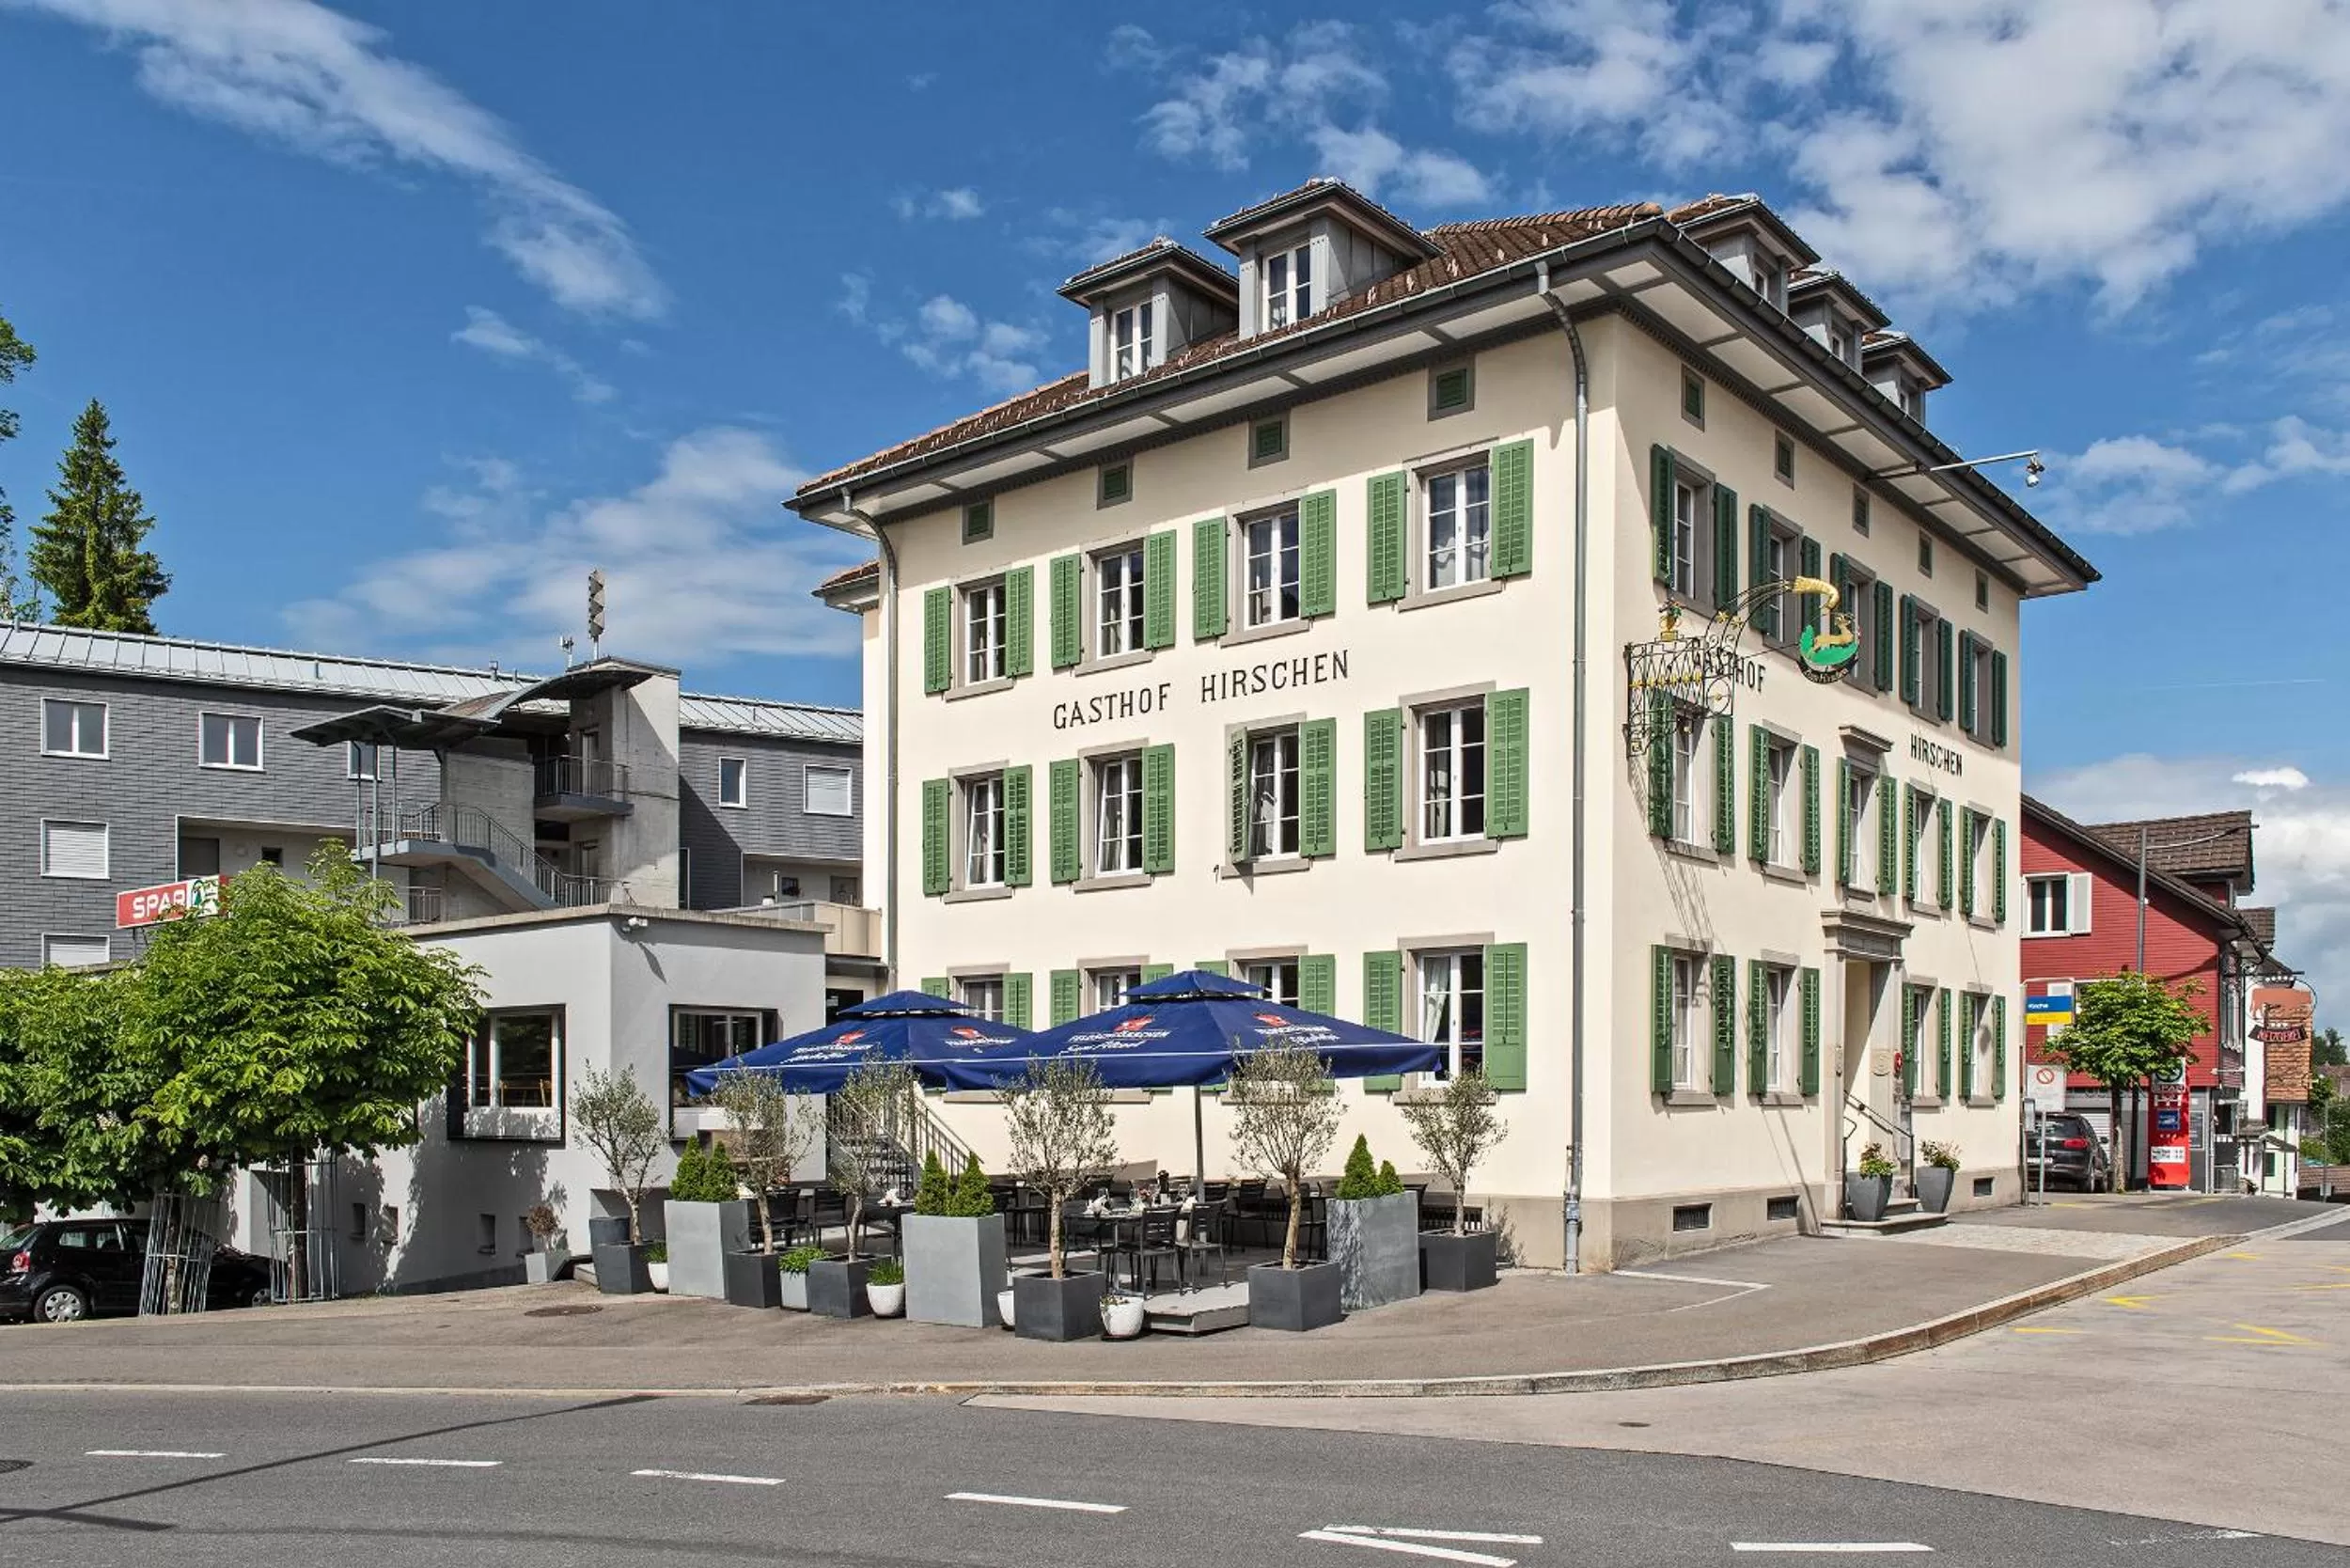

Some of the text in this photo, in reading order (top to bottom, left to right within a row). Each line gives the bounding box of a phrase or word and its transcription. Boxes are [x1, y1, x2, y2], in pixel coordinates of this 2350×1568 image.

[1054, 649, 1348, 729] GASTHOF HIRSCHEN
[1910, 732, 1963, 778] HIRSCHEN
